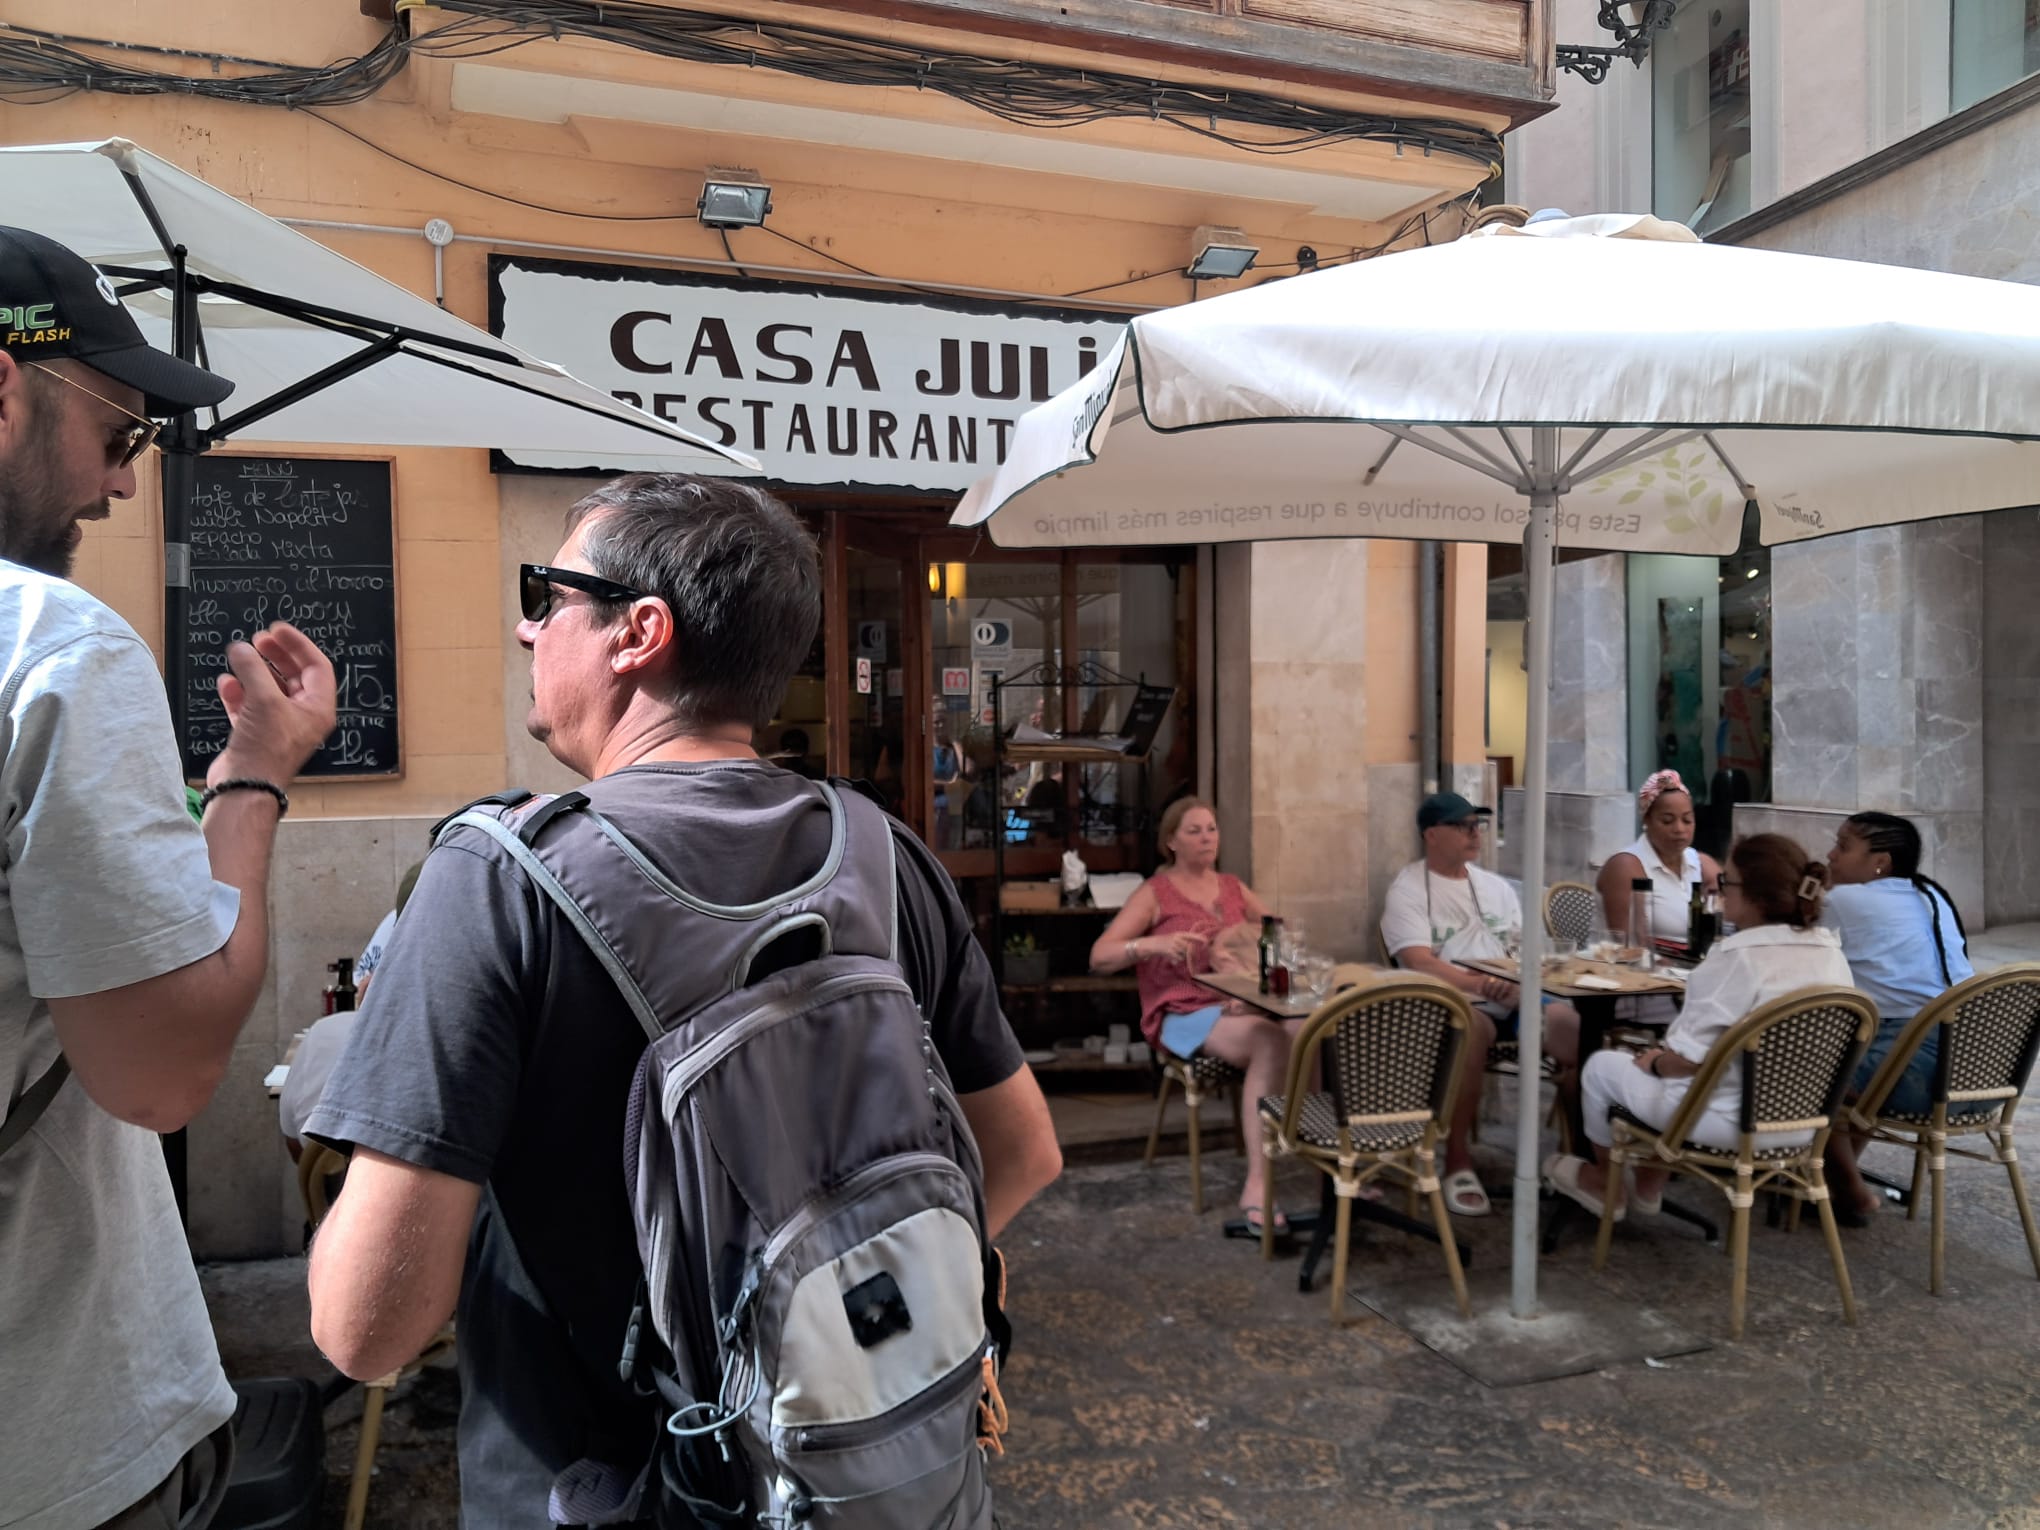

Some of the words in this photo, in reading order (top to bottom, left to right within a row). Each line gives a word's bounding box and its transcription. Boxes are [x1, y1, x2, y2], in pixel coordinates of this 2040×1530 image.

[0, 303, 55, 331] PIC
[6, 327, 70, 345] FLASH
[609, 309, 882, 392] CASA
[915, 336, 1097, 403] JULi
